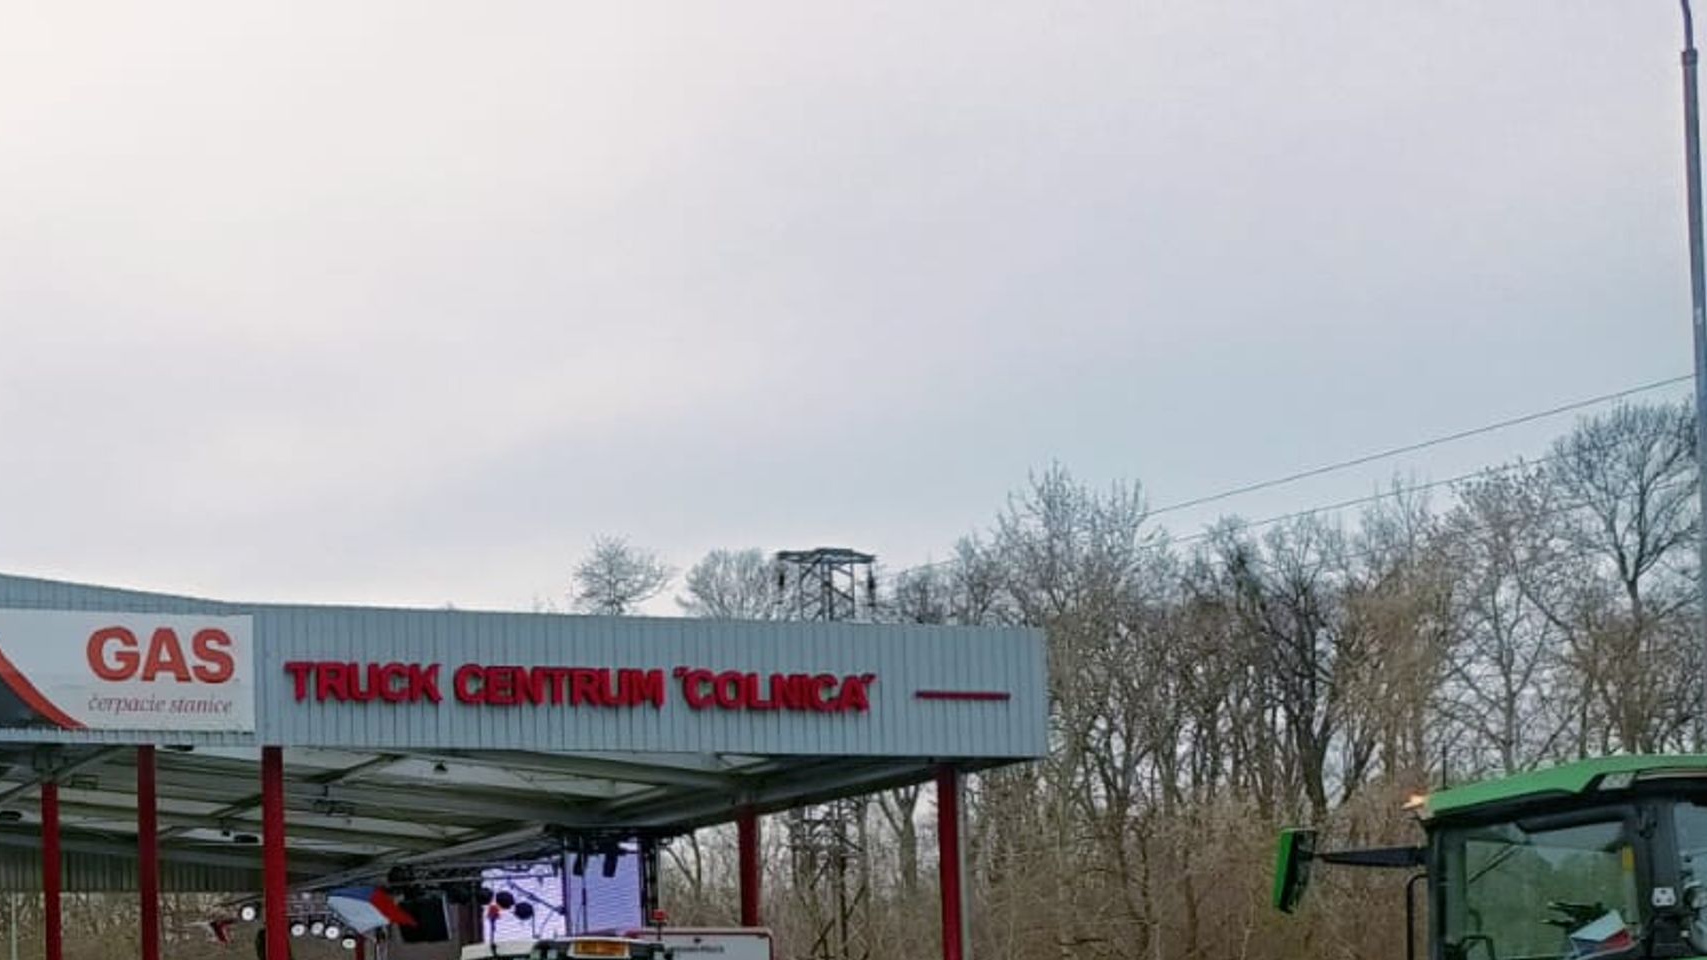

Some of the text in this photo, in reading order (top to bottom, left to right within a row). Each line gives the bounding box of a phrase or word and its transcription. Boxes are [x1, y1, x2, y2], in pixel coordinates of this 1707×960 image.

[87, 626, 234, 684] GAS
[169, 694, 232, 713] stanice
[283, 660, 443, 704] TRUCK
[453, 663, 663, 708] CENTRUM
